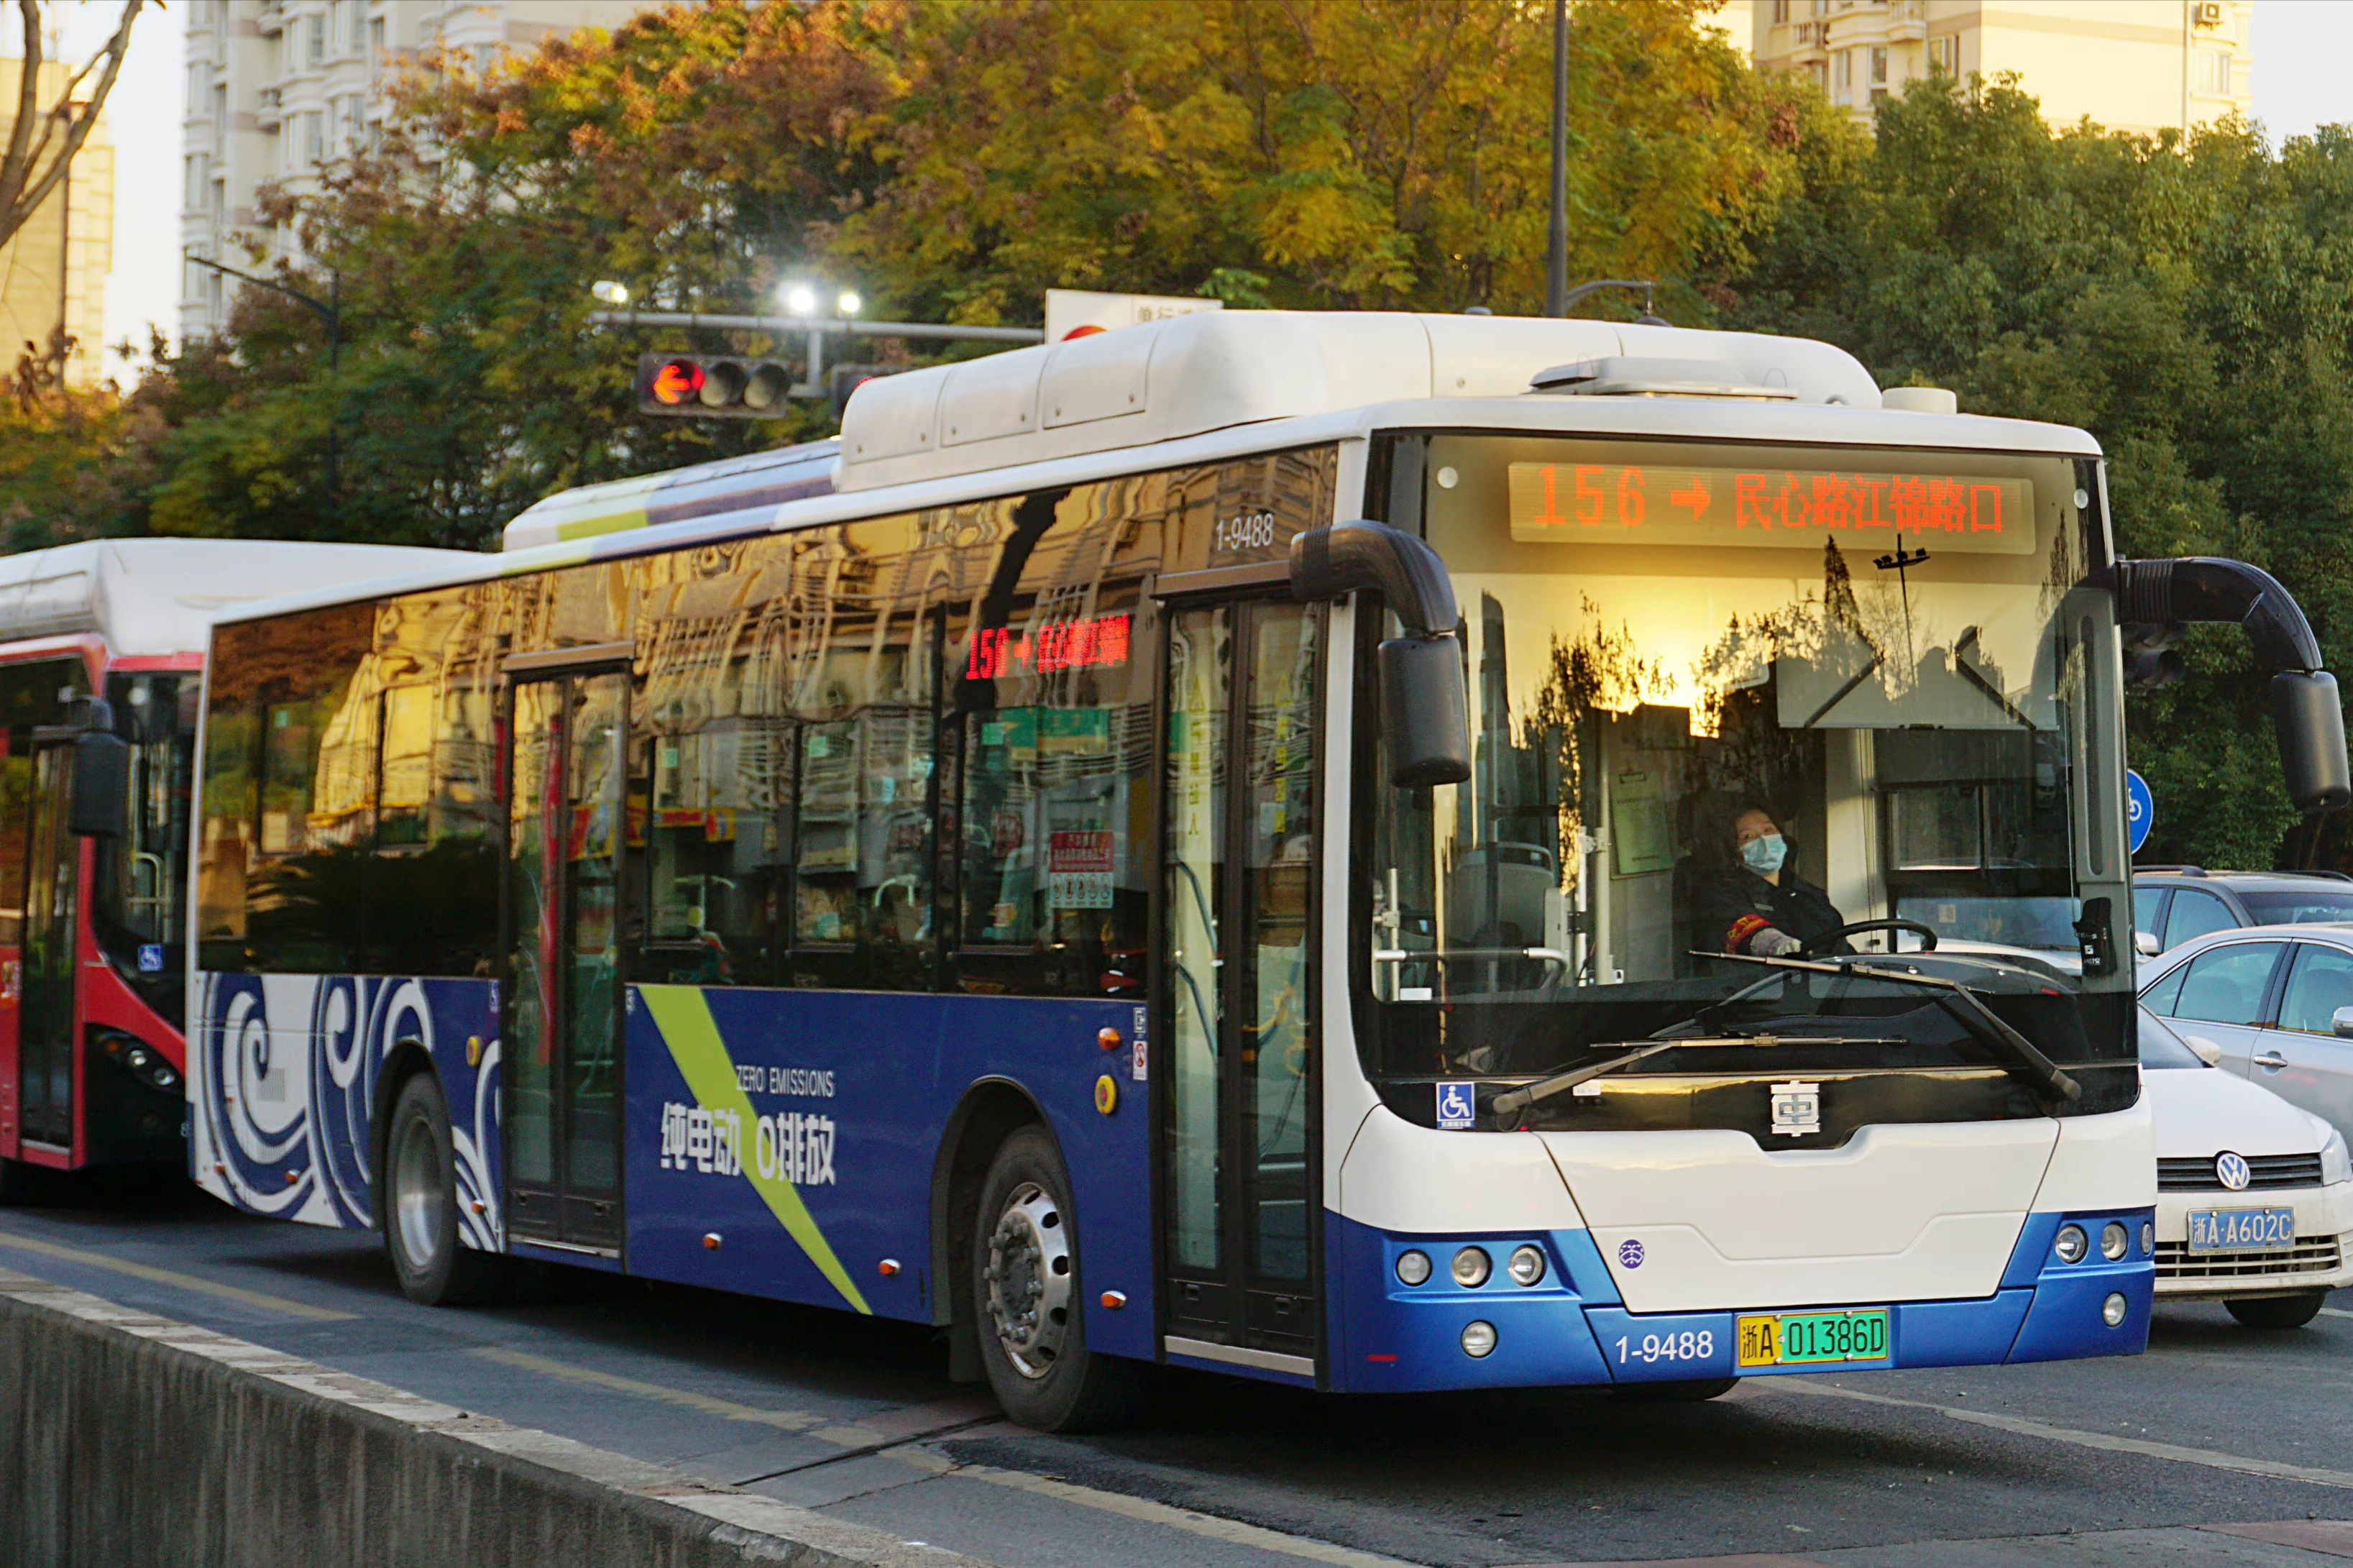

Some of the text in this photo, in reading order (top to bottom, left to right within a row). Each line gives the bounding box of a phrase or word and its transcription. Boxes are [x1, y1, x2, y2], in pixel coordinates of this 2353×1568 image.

[1534, 464, 2002, 535] 156 民心路江锦路口
[1216, 513, 1275, 551] 1-9488
[966, 627, 1009, 680] 156
[735, 1064, 835, 1098] ZERO EMISSIONS
[660, 1101, 740, 1177] 纯电动
[1615, 1330, 1714, 1365] 1-9488
[1788, 1318, 1885, 1357] 01386D
